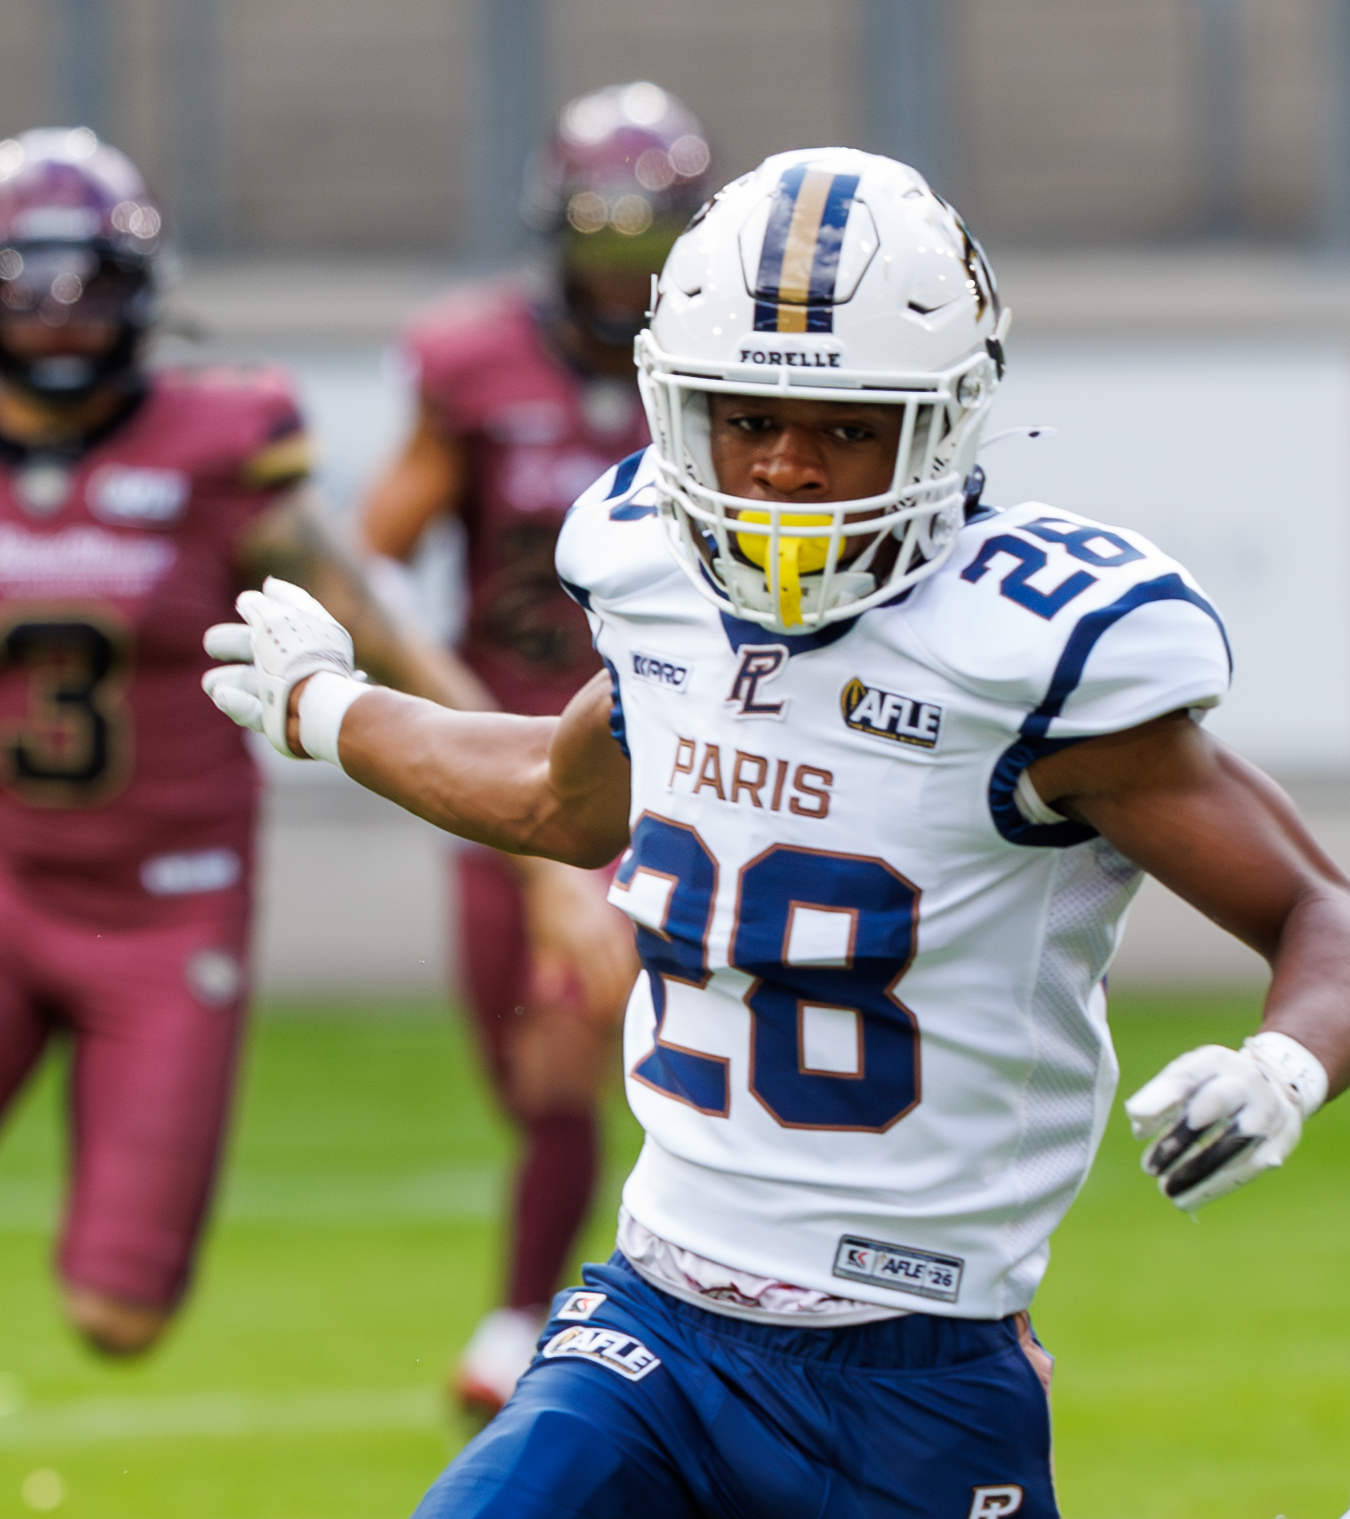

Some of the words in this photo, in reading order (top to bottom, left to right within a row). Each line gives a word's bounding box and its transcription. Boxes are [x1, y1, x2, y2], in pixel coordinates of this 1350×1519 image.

[739, 349, 841, 368] FORELLE
[960, 517, 1147, 621] 28
[849, 688, 940, 741] AFLE
[668, 735, 834, 820] PARIS
[607, 809, 923, 1135] 28
[881, 1258, 927, 1280] AFLE
[555, 1329, 656, 1373] AFLE
